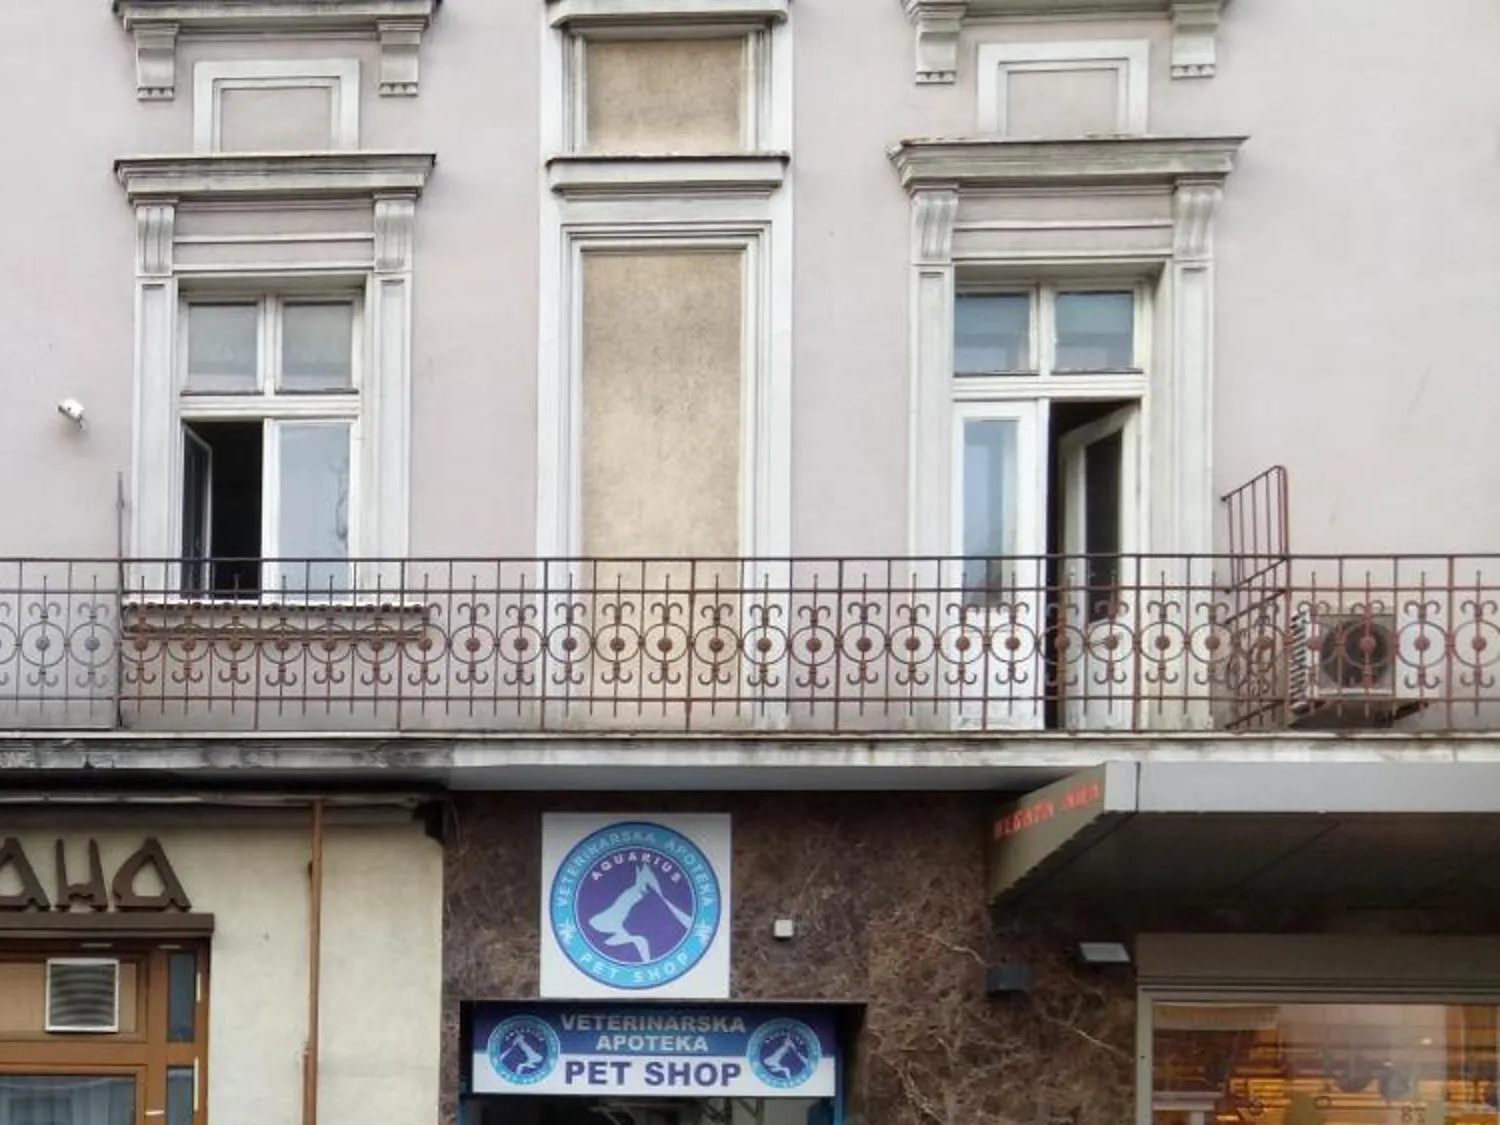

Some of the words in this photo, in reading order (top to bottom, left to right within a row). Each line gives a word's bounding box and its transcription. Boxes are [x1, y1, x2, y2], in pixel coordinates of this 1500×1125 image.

[591, 851, 683, 884] AQUARIUS
[579, 952, 618, 980] PET
[632, 952, 689, 984] SHOP
[560, 1012, 747, 1034] VETERINARSKA
[595, 1034, 709, 1053] APOTEKA
[564, 1060, 632, 1086] PET
[643, 1061, 742, 1088] SHOP
